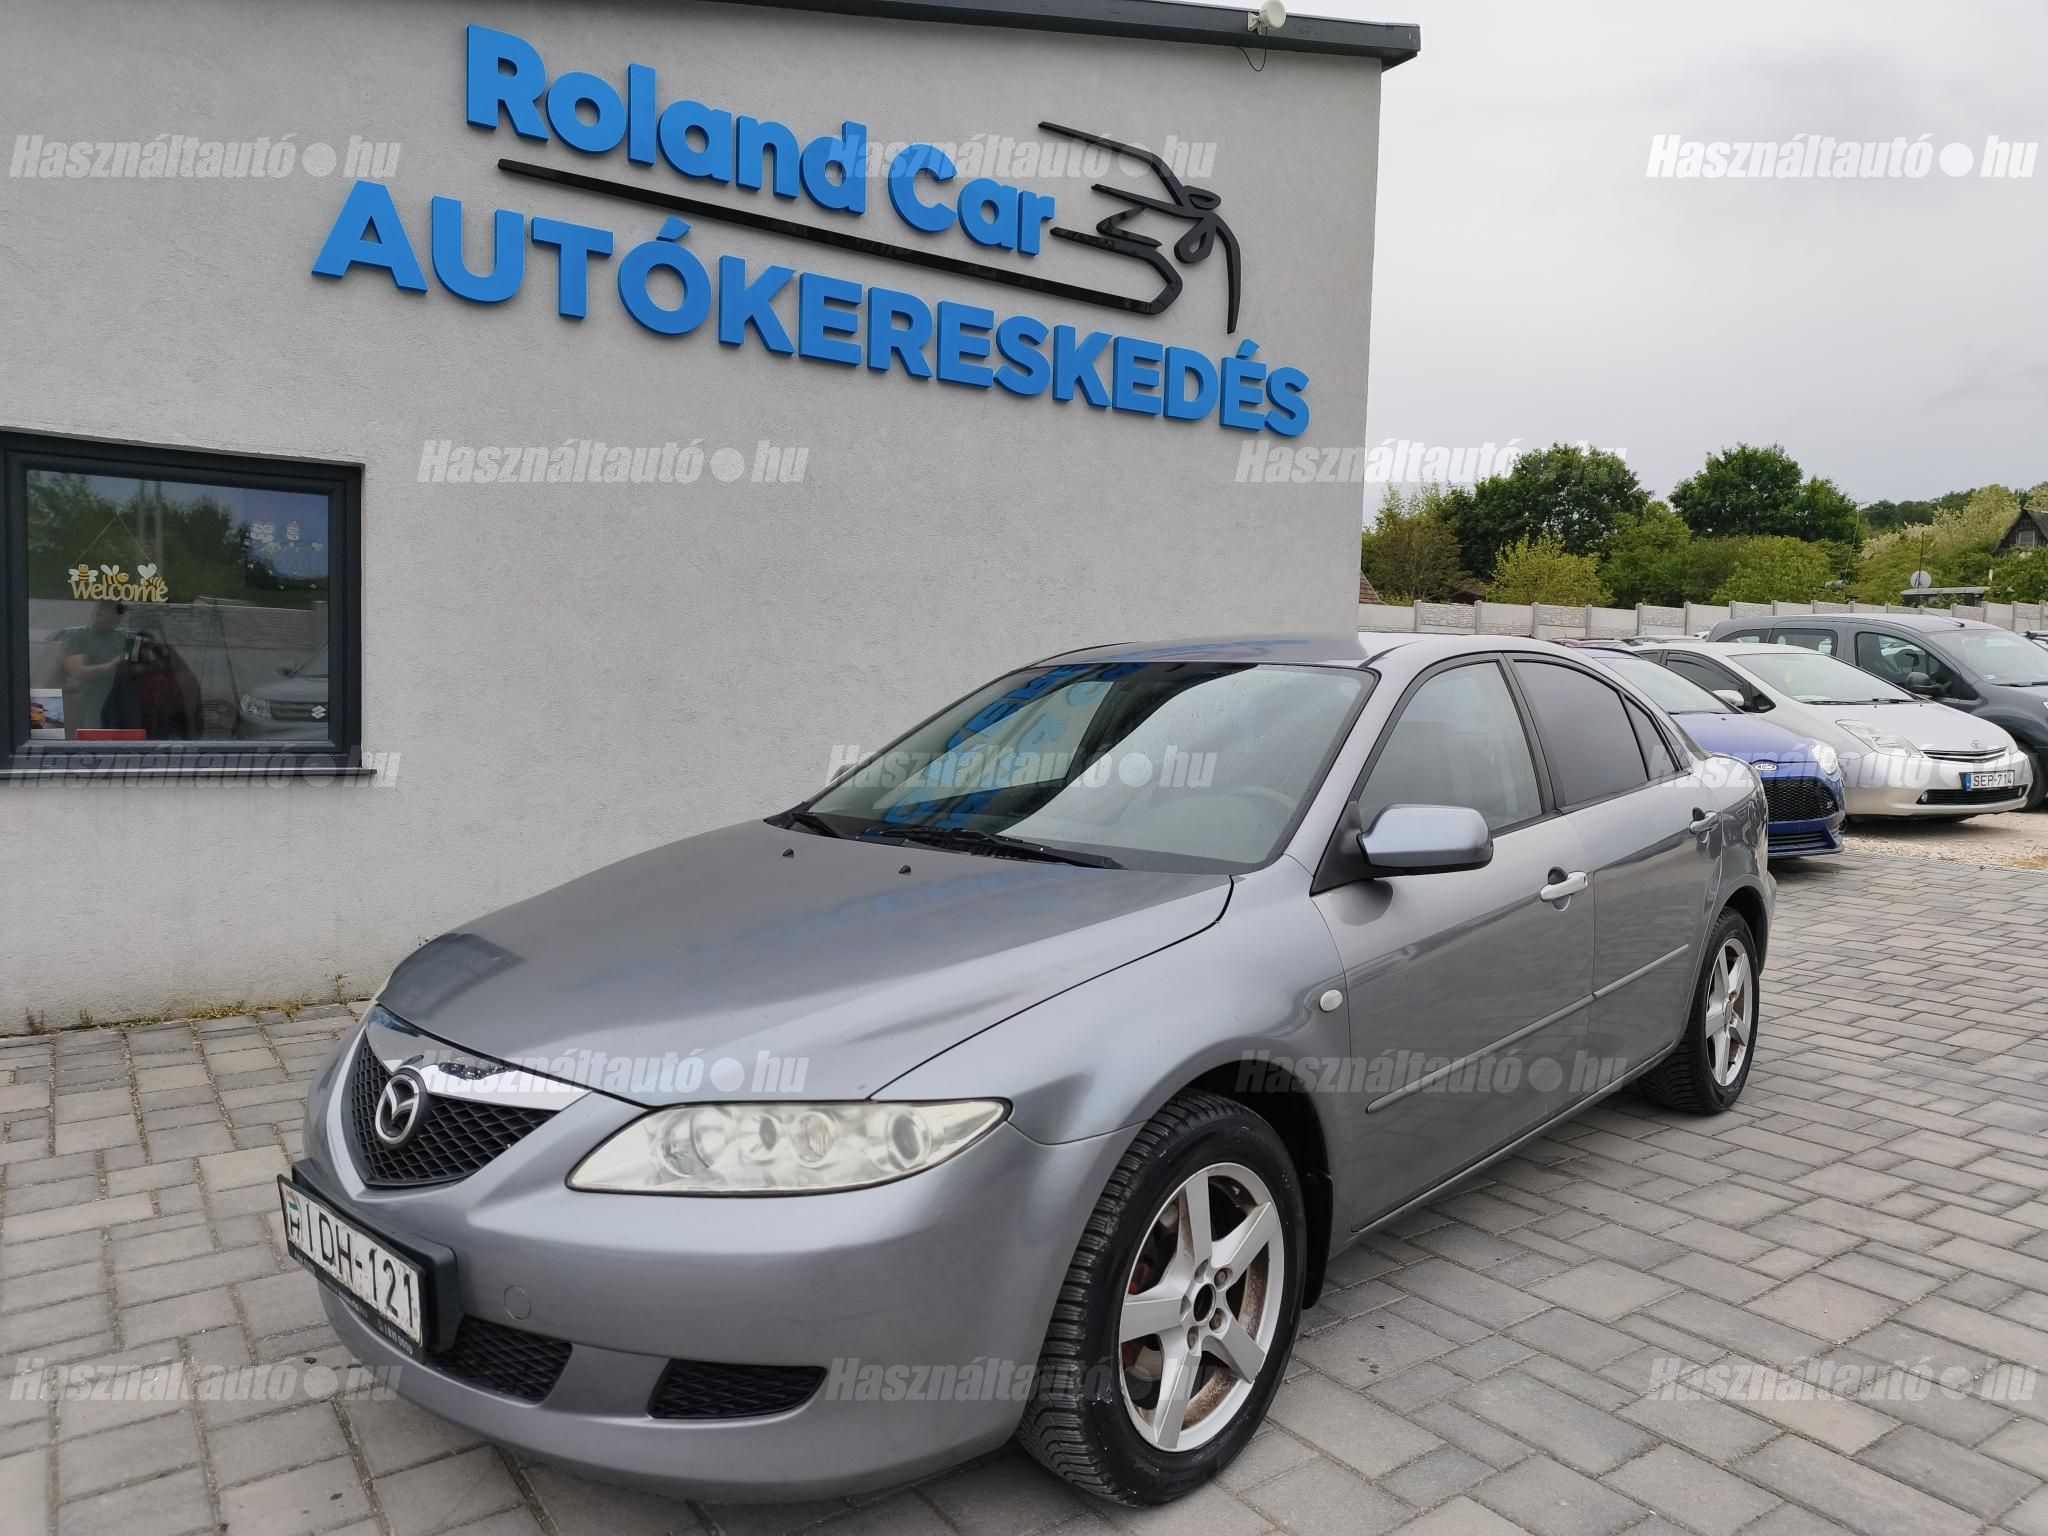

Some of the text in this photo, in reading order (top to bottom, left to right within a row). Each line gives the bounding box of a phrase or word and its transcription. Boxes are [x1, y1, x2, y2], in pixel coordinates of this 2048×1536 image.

[466, 23, 1055, 256] Roland Car
[311, 179, 1310, 437] AUTÓKERESKEDÉS
[68, 574, 169, 603] Welcome
[1973, 773, 2012, 787] SEP-714
[306, 1202, 414, 1329] IDH-121
